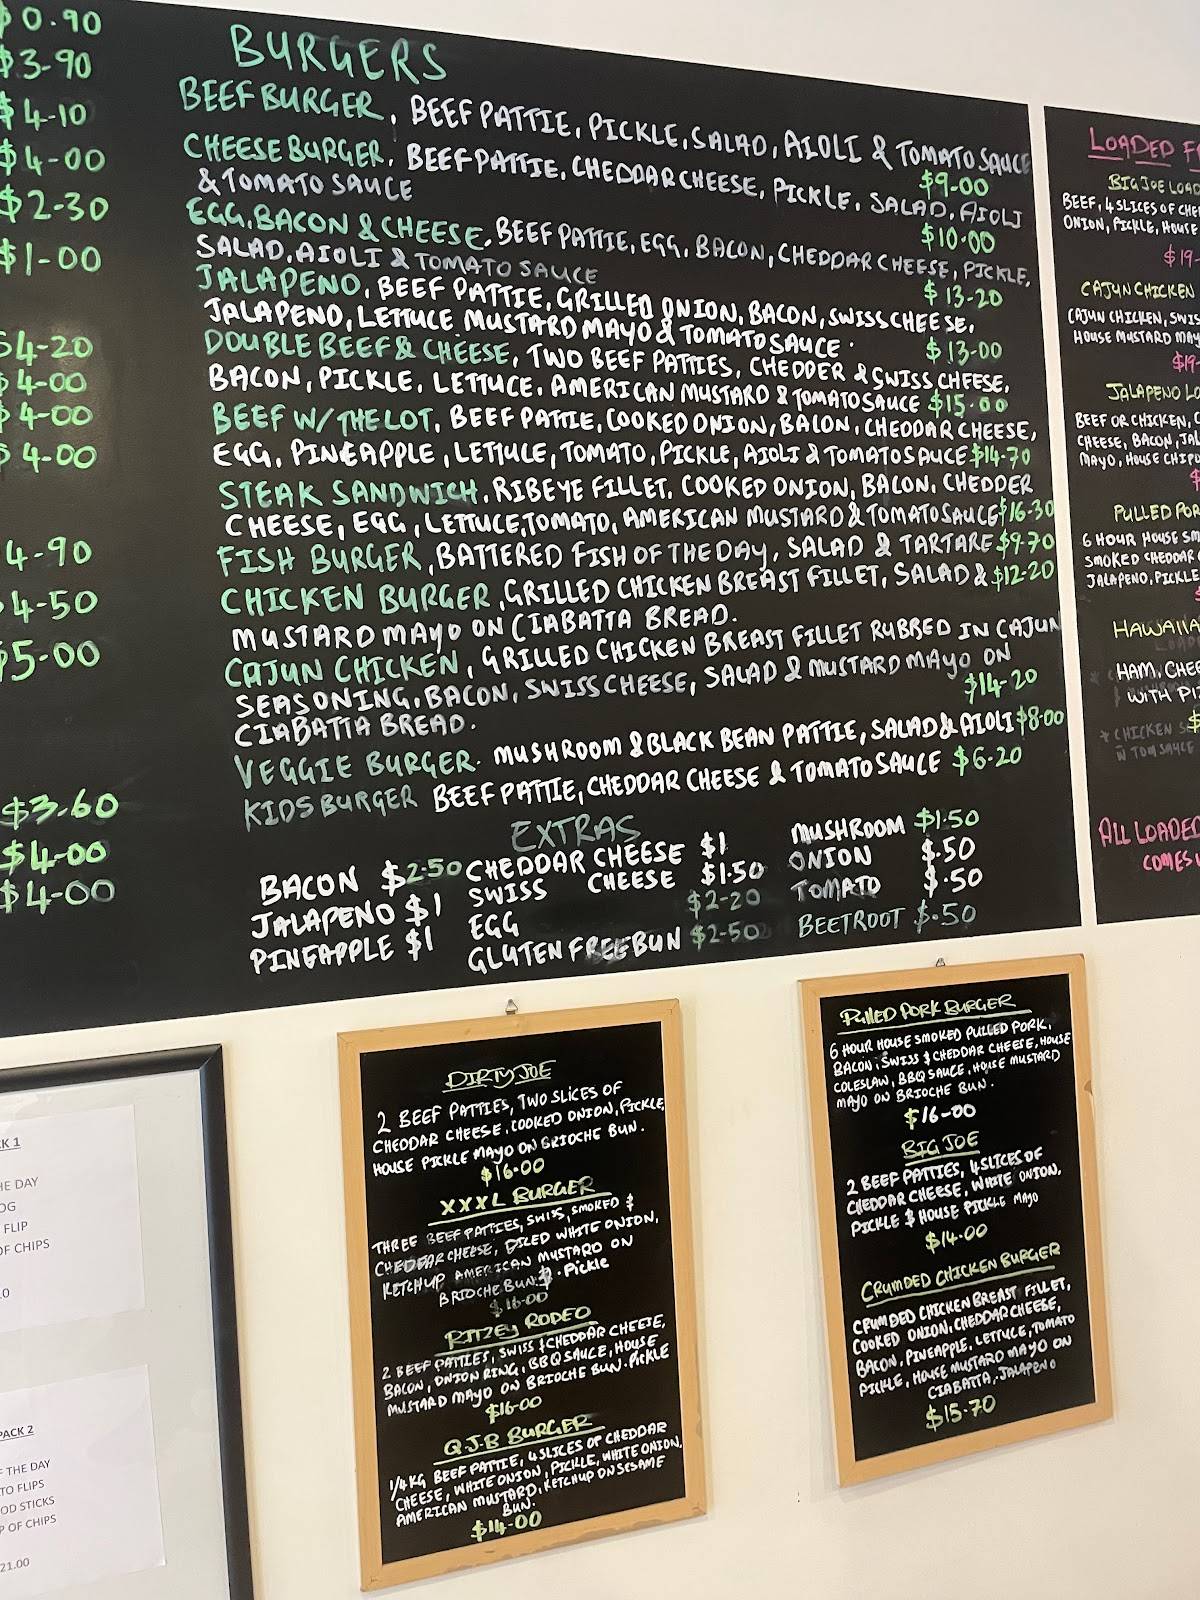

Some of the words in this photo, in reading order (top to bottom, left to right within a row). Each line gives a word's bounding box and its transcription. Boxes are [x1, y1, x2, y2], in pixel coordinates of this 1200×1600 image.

[231, 23, 447, 84] BURGERS
[411, 95, 472, 128] BEEF
[1089, 127, 1175, 158] LOADED
[222, 167, 324, 196] TOMATO
[332, 173, 412, 201] SAUCE
[1162, 220, 1198, 235] HOUSE
[414, 253, 511, 277] TOMATO
[519, 260, 598, 284] SAUCE
[377, 276, 445, 300] BEEF
[1081, 280, 1131, 299] CAJUN
[1134, 282, 1194, 299] CHICKEN
[1068, 308, 1105, 325] CAJUN
[1074, 330, 1112, 344] HOUSE
[1116, 330, 1171, 345] MUSTARD
[205, 329, 311, 359] DOUBLE
[319, 332, 390, 360] BEEF
[526, 343, 583, 368] TWO
[750, 356, 846, 381] CHEDDER
[681, 383, 769, 406] MUSTARD
[1106, 383, 1181, 402] JALAPENO
[213, 402, 285, 435] BEEF
[450, 404, 514, 429] BEEF
[1075, 412, 1107, 428] BEEF
[1111, 414, 1129, 428] OR
[1126, 452, 1159, 466] HOUSE
[219, 481, 323, 510] STEAK
[492, 476, 583, 503] RIBEYE
[682, 474, 767, 499] COOKED
[943, 471, 1033, 495] CHEDDER
[623, 507, 737, 530] AMERICAN
[747, 505, 844, 527] MUSTARD
[1114, 504, 1171, 522] PULLED
[1096, 532, 1136, 546] HOUR
[1142, 531, 1178, 547] HOUSE
[217, 546, 295, 577] FISH
[311, 541, 421, 574] BURGER
[787, 535, 863, 558] SALAD
[875, 532, 892, 557] &
[899, 532, 993, 554] TARTARE
[1085, 552, 1139, 568] SMOKED
[221, 583, 363, 616] CHICKEN
[379, 583, 490, 614] BURGER
[617, 574, 711, 599] CHICKEN
[718, 567, 799, 595] BREAST
[894, 562, 969, 586] SALAD
[974, 563, 988, 586] &
[232, 624, 375, 651] MUSTARD
[472, 617, 503, 637] ON
[512, 609, 631, 643] CIABATTA
[225, 658, 323, 688] CAJUN
[482, 645, 589, 674] GRILLED
[704, 629, 783, 657] BREAST
[792, 622, 862, 647] FILLET
[958, 623, 989, 640] IN
[704, 660, 777, 688] SALAD
[784, 656, 802, 682] &
[809, 655, 900, 677] MUSTARD
[984, 642, 1011, 665] ON
[1127, 688, 1172, 703] WITH
[235, 715, 370, 747] CIABATTA
[234, 755, 352, 789] VEGGIE
[494, 737, 622, 765] MUSHROOM
[647, 731, 714, 756] BLACK
[720, 727, 774, 752] BEAN
[245, 796, 314, 832] KIDS
[321, 784, 417, 817] BURGER
[433, 782, 495, 812] BEEF
[687, 766, 759, 792] CHEESE
[769, 760, 786, 785] &
[511, 814, 641, 852] EXTRAS
[1099, 817, 1131, 847] ALL
[260, 865, 358, 906] BACON
[466, 849, 585, 882] CHEDDAR
[594, 839, 685, 868] CHEESE
[700, 832, 726, 859] $1
[791, 815, 905, 844] MUSHROOM
[251, 900, 395, 939] JALAPENO
[405, 893, 441, 927] $1
[469, 878, 547, 907] SWISS
[588, 870, 675, 893] CHEESE
[789, 845, 871, 871] ONION
[250, 934, 394, 974] PINEAPPLE
[405, 926, 433, 961] $1
[468, 911, 519, 940] EGG
[468, 940, 562, 974] GLUTEN
[798, 908, 905, 938] BEETROOT
[900, 1000, 941, 1020] PORK
[944, 994, 1017, 1015] BURGER
[842, 1039, 873, 1057] HOUR
[877, 1035, 911, 1050] HOUSE
[915, 1028, 961, 1044] SMOKED
[966, 1023, 1008, 1040] PULLED
[881, 1051, 919, 1068] SWISS
[1040, 1032, 1071, 1045] HOUSE
[899, 1070, 925, 1085] BBQ
[1010, 1049, 1060, 1065] MUSTARD
[378, 1111, 391, 1134] 2
[399, 1105, 442, 1128] BEEF
[517, 1093, 547, 1110] TWO
[603, 1081, 622, 1096] OF
[874, 1091, 890, 1104] ON
[896, 1083, 952, 1102] BRIOCHE
[14, 1137, 20, 1146] 1
[373, 1133, 438, 1153] CHEDDAR
[901, 1139, 940, 1159] BIG
[942, 1131, 979, 1151] JOE
[373, 1158, 413, 1176] HOUSE
[421, 1150, 469, 1170] PICKLE
[517, 1139, 537, 1154] ON
[15, 1177, 38, 1189] DAY
[512, 1176, 595, 1205] BURGER
[861, 1172, 899, 1191] BEEF
[971, 1171, 1012, 1191] WHITE
[4, 1222, 27, 1234] FLIP
[851, 1214, 899, 1237] PICKLE
[918, 1205, 959, 1225] HOUSE
[964, 1196, 1006, 1215] PICKLE
[15, 1239, 49, 1253] CHIPS
[371, 1235, 417, 1254] THREE
[538, 1242, 602, 1264] MUSTARD
[611, 1235, 633, 1248] ON
[936, 1259, 997, 1287] CHICKEN
[1000, 1242, 1060, 1268] BURGER
[919, 1296, 971, 1321] CHICKEN
[973, 1285, 1017, 1307] BREAST
[525, 1306, 591, 1329] RODEO
[615, 1334, 658, 1354] HOUSE
[853, 1332, 900, 1355] COOKED
[951, 1350, 1004, 1374] MUSTARD
[1053, 1335, 1072, 1349] ON
[388, 1395, 447, 1416] MUSTARD
[501, 1379, 520, 1394] ON
[526, 1366, 586, 1390] BRIOCHE
[28, 1425, 33, 1433] 2
[507, 1414, 594, 1445] BURGER
[605, 1422, 668, 1445] CHEDDAR
[6, 1464, 27, 1476] THE
[31, 1459, 50, 1471] DAY
[18, 1480, 44, 1492] FLIPS
[20, 1496, 54, 1511] STICKS
[396, 1501, 467, 1526] AMERICAN
[8, 1521, 22, 1532] OF
[26, 1514, 56, 1528] CHIPS
